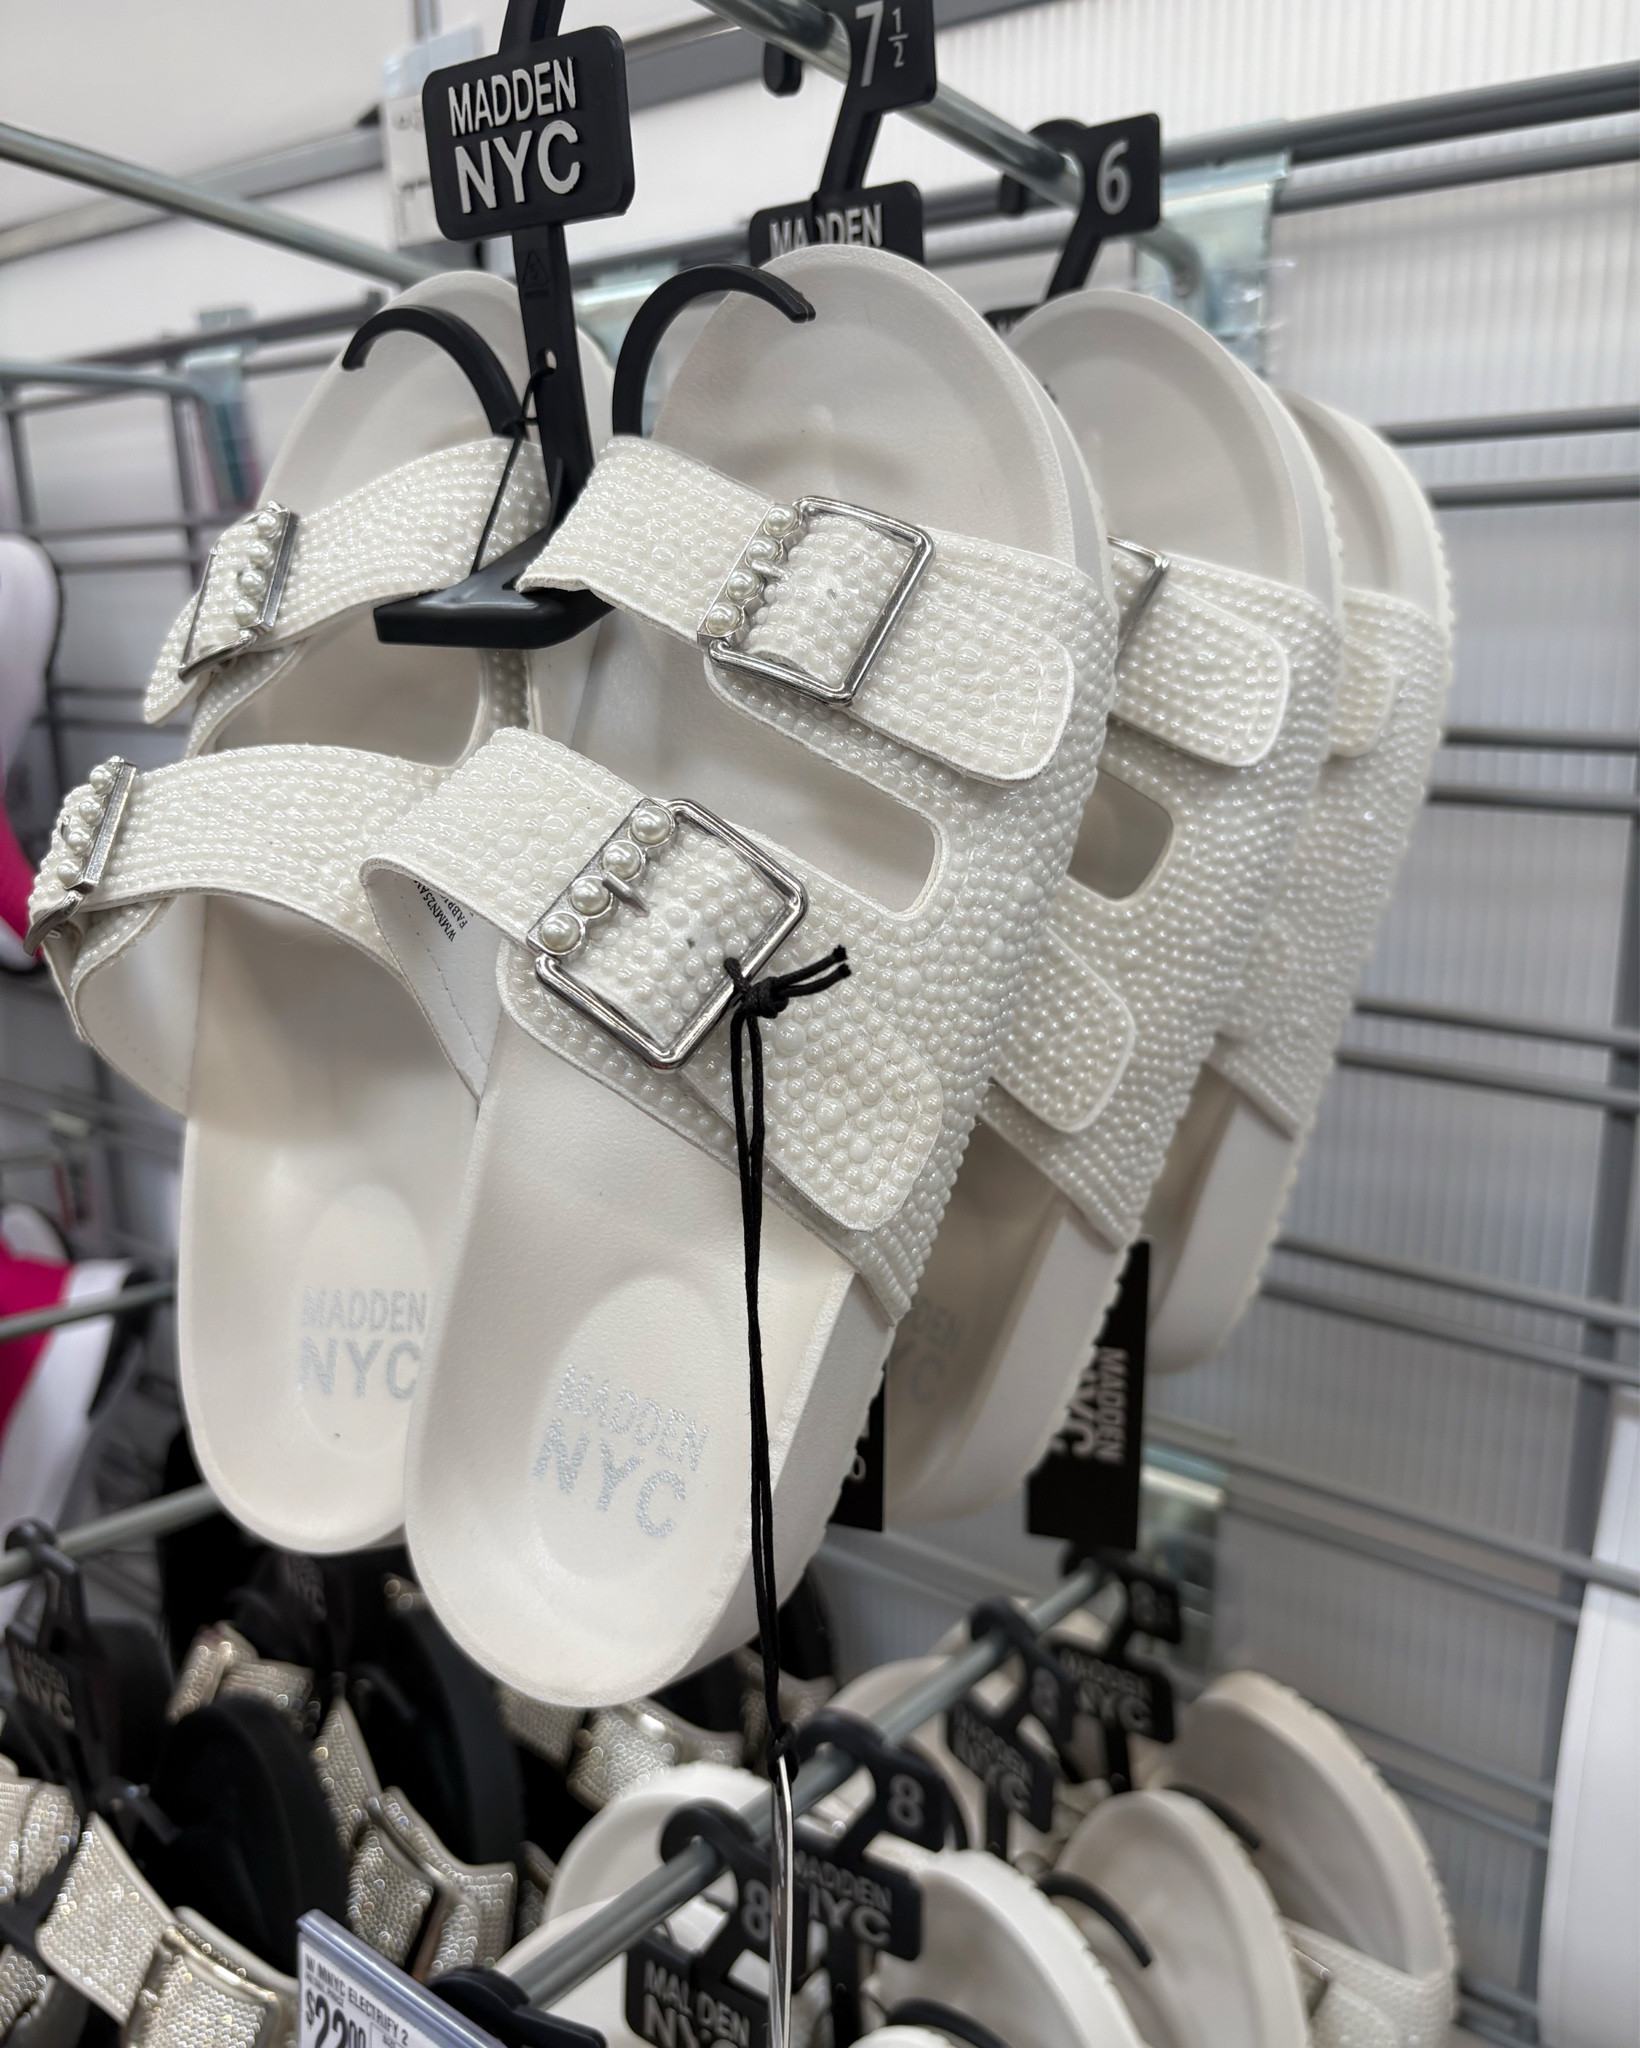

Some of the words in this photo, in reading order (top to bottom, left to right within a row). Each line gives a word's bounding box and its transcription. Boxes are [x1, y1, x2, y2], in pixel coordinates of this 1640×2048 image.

[447, 56, 577, 138] MADDEN
[454, 119, 581, 214] NYC
[1097, 139, 1130, 216] 6
[441, 895, 468, 929] FABR
[302, 1288, 428, 1334] MADDEN
[302, 1337, 422, 1400] NYC
[1096, 1345, 1128, 1462] MADDEN
[557, 1363, 709, 1472] MADDEN
[532, 1416, 686, 1538] NYC
[888, 1773, 925, 1830] 8
[741, 1879, 771, 1943] 8
[349, 1985, 399, 2039] ELECTRIFY
[402, 2029, 409, 2046] 2
